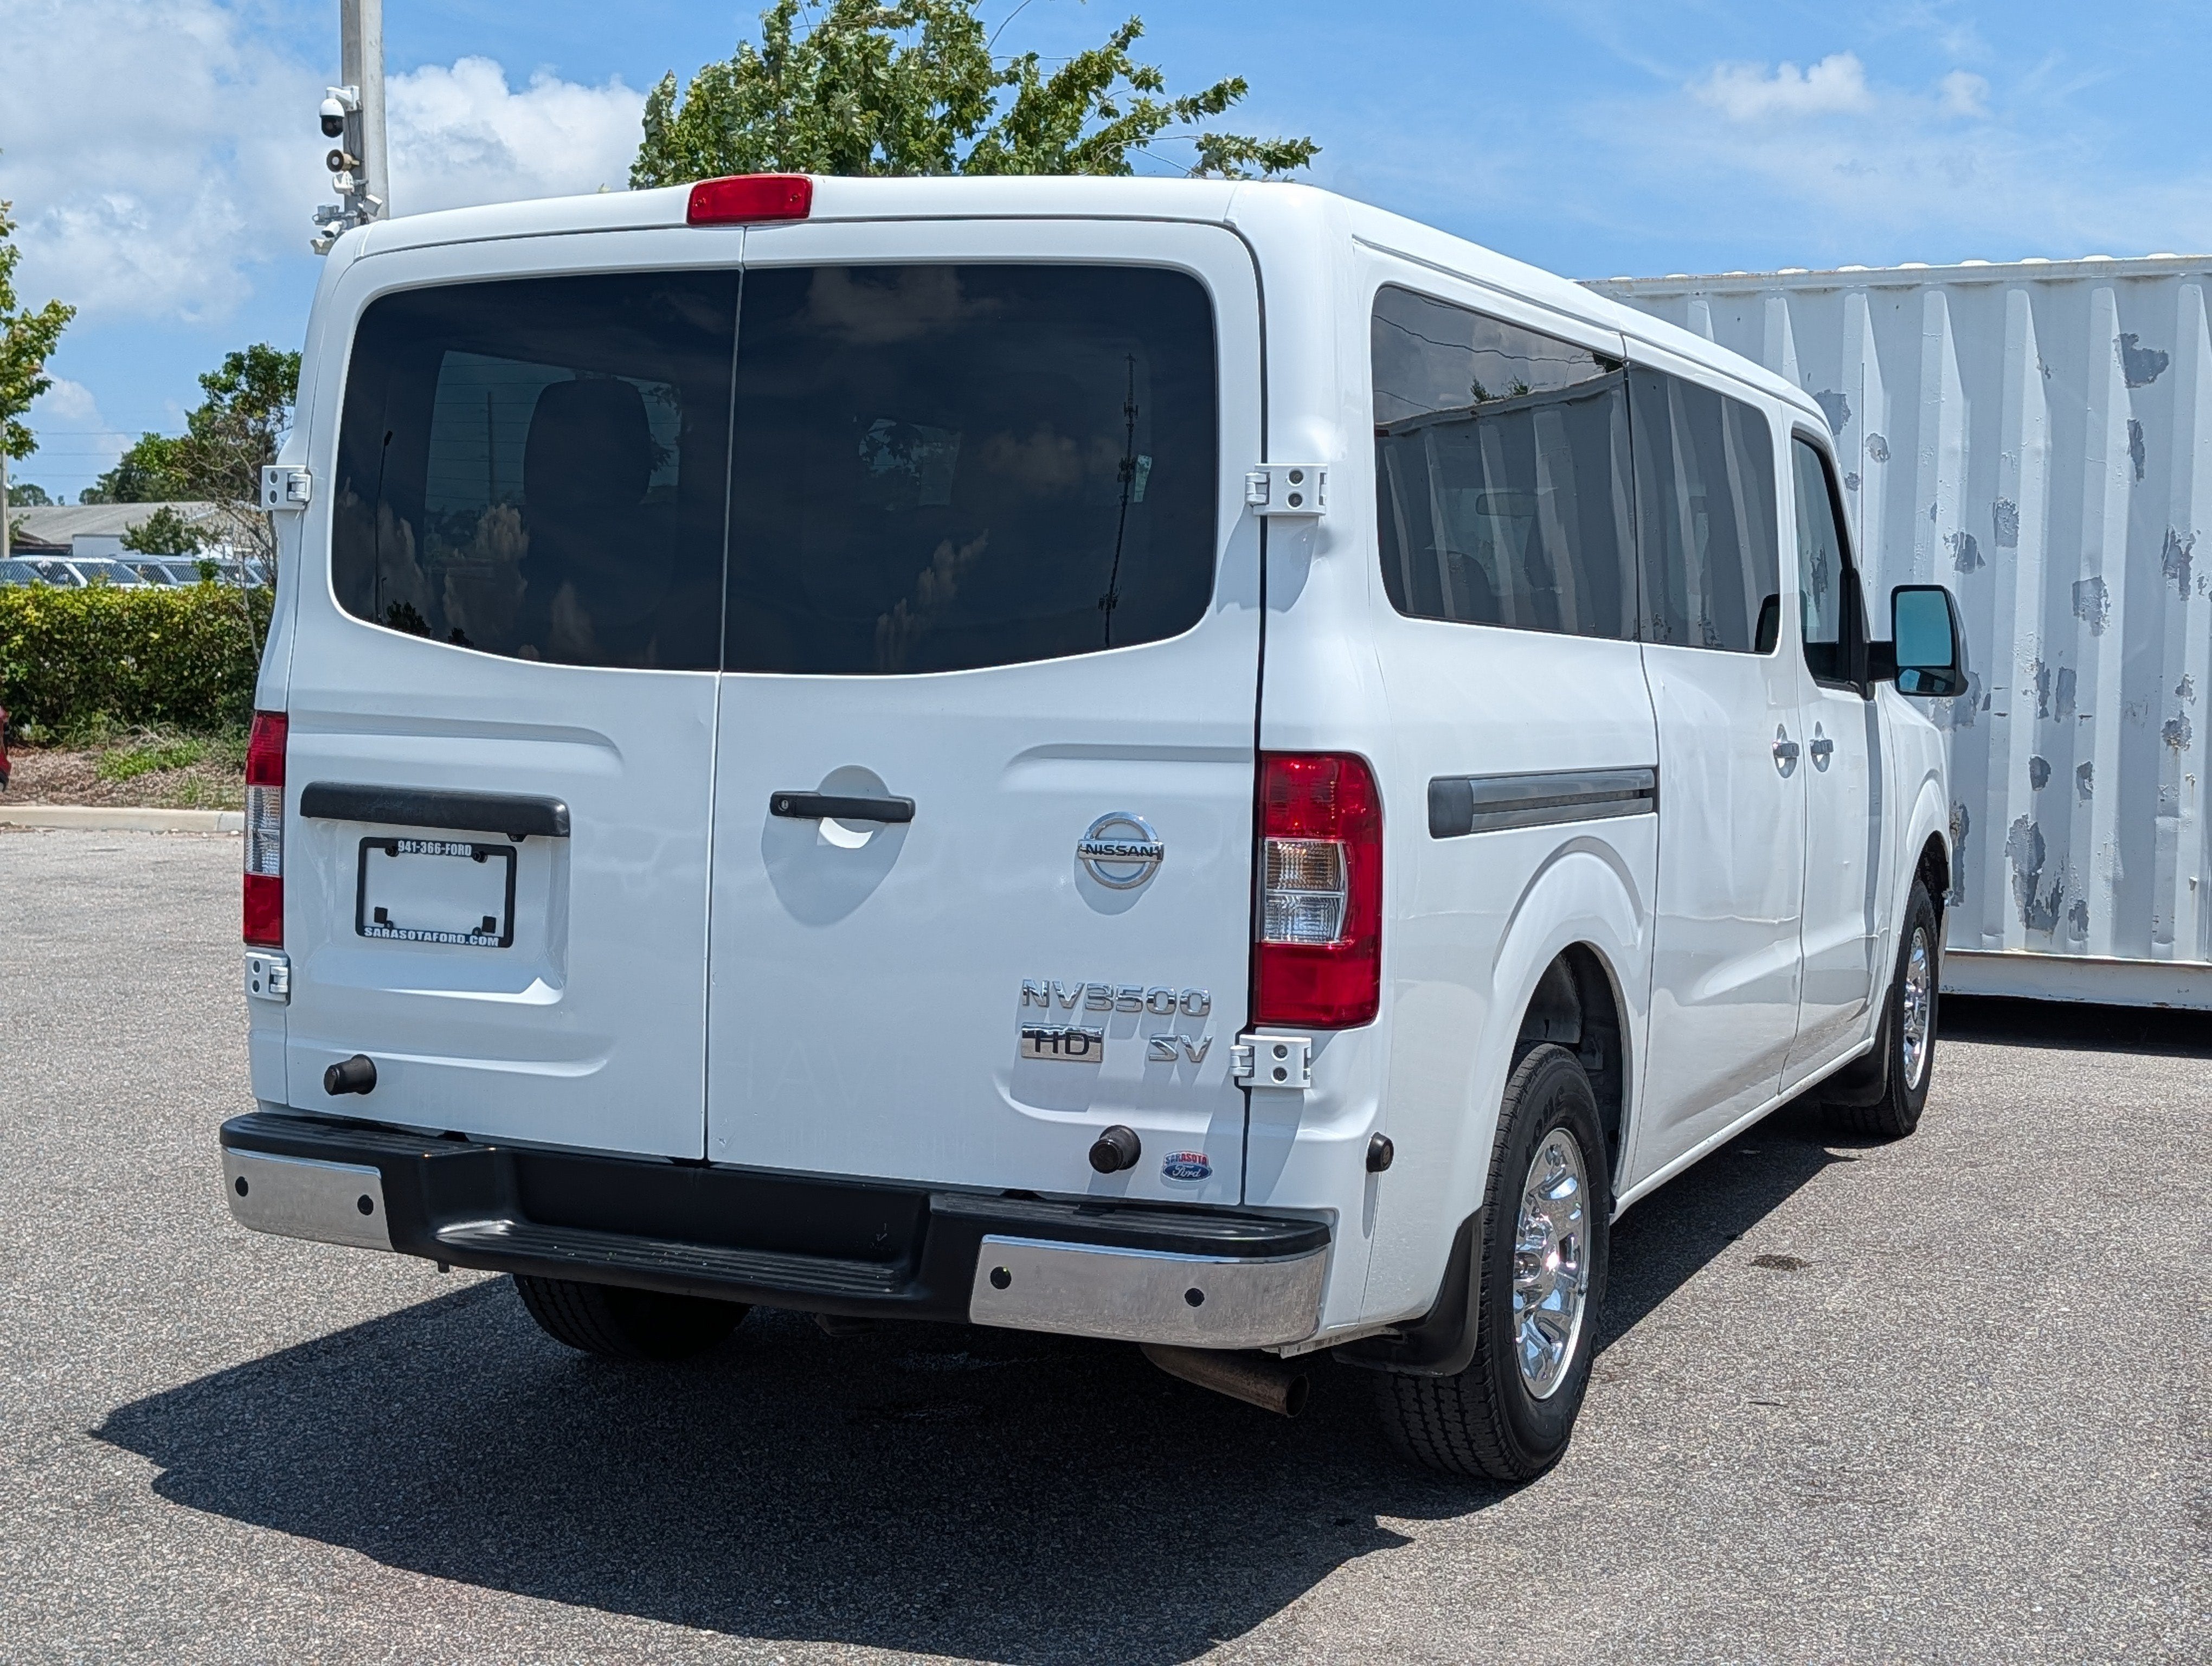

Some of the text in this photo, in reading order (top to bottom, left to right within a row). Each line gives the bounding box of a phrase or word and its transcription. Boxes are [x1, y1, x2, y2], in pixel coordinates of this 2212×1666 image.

[398, 840, 472, 856] 941-366-FORD
[1085, 844, 1155, 857] NISSAN
[364, 927, 499, 947] SARASOTAFORD.COM
[1022, 979, 1211, 1016] NV3500
[1035, 1029, 1090, 1055] HD
[1148, 1033, 1214, 1063] SV
[1165, 1153, 1207, 1167] SARASOTA
[1172, 1164, 1201, 1177] Ford
